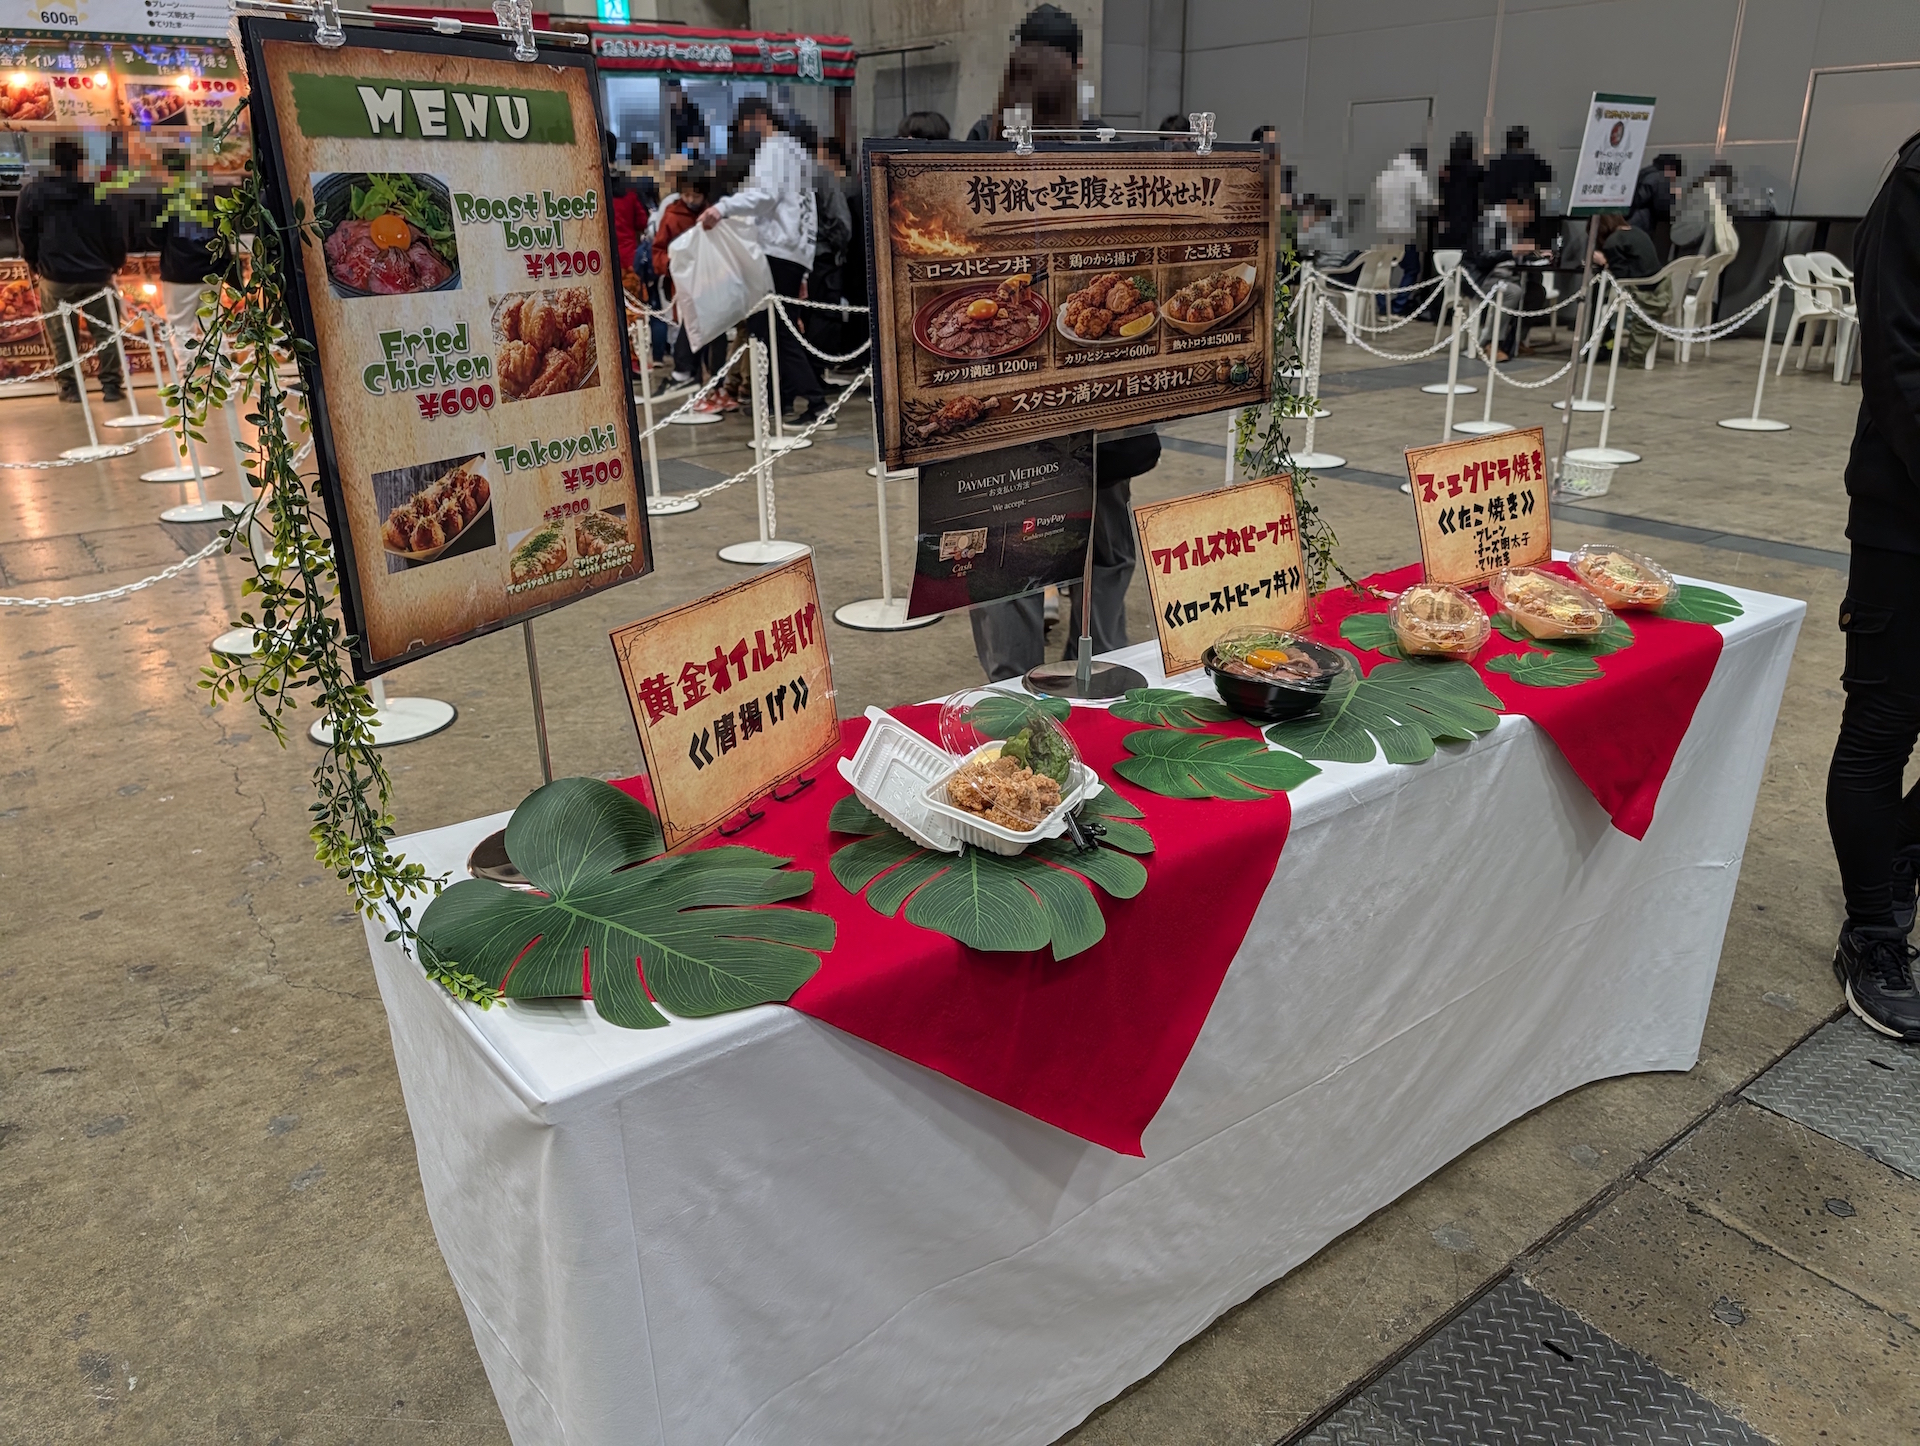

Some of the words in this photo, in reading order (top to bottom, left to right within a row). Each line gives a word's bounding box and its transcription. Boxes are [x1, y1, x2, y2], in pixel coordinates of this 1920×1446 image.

[41, 11, 79, 26] 600円
[356, 85, 532, 140] MENU
[452, 190, 539, 224] Roast
[541, 188, 598, 220] beef
[965, 174, 1222, 215] 狩猟で空腹を討伐せよ!!
[501, 219, 565, 250] bowl
[522, 249, 602, 280] ¥1200
[1068, 250, 1140, 269] 鶏のから揚げ
[1183, 244, 1232, 259] たこ焼き
[926, 254, 1032, 278] ローストビーフ丼
[377, 321, 470, 361] Fried
[1129, 343, 1156, 358] 600円
[1215, 332, 1242, 346] 500円
[362, 352, 491, 395] Chicken
[932, 366, 996, 384] ガッツリ満足!
[997, 358, 1038, 374] 1200円
[415, 384, 496, 420] ¥600
[1011, 381, 1122, 413] スタミナ満タン!
[1125, 366, 1194, 397] 旨さ狩れ!
[493, 423, 618, 473] Takoyaki
[561, 457, 624, 492] ¥500
[988, 481, 1031, 497] お支払い方法
[543, 497, 590, 521] +¥200
[992, 504, 1004, 513] We
[1036, 513, 1067, 528] PayPay
[573, 554, 601, 569] Spicy
[601, 547, 618, 562] cod
[619, 543, 635, 554] roe
[577, 562, 602, 578] with
[602, 554, 632, 570] cheese
[952, 561, 973, 574] Cash
[506, 572, 554, 595] Teriyaki
[555, 568, 574, 582] Egg
[638, 602, 816, 728] 黄金オイル揚げ
